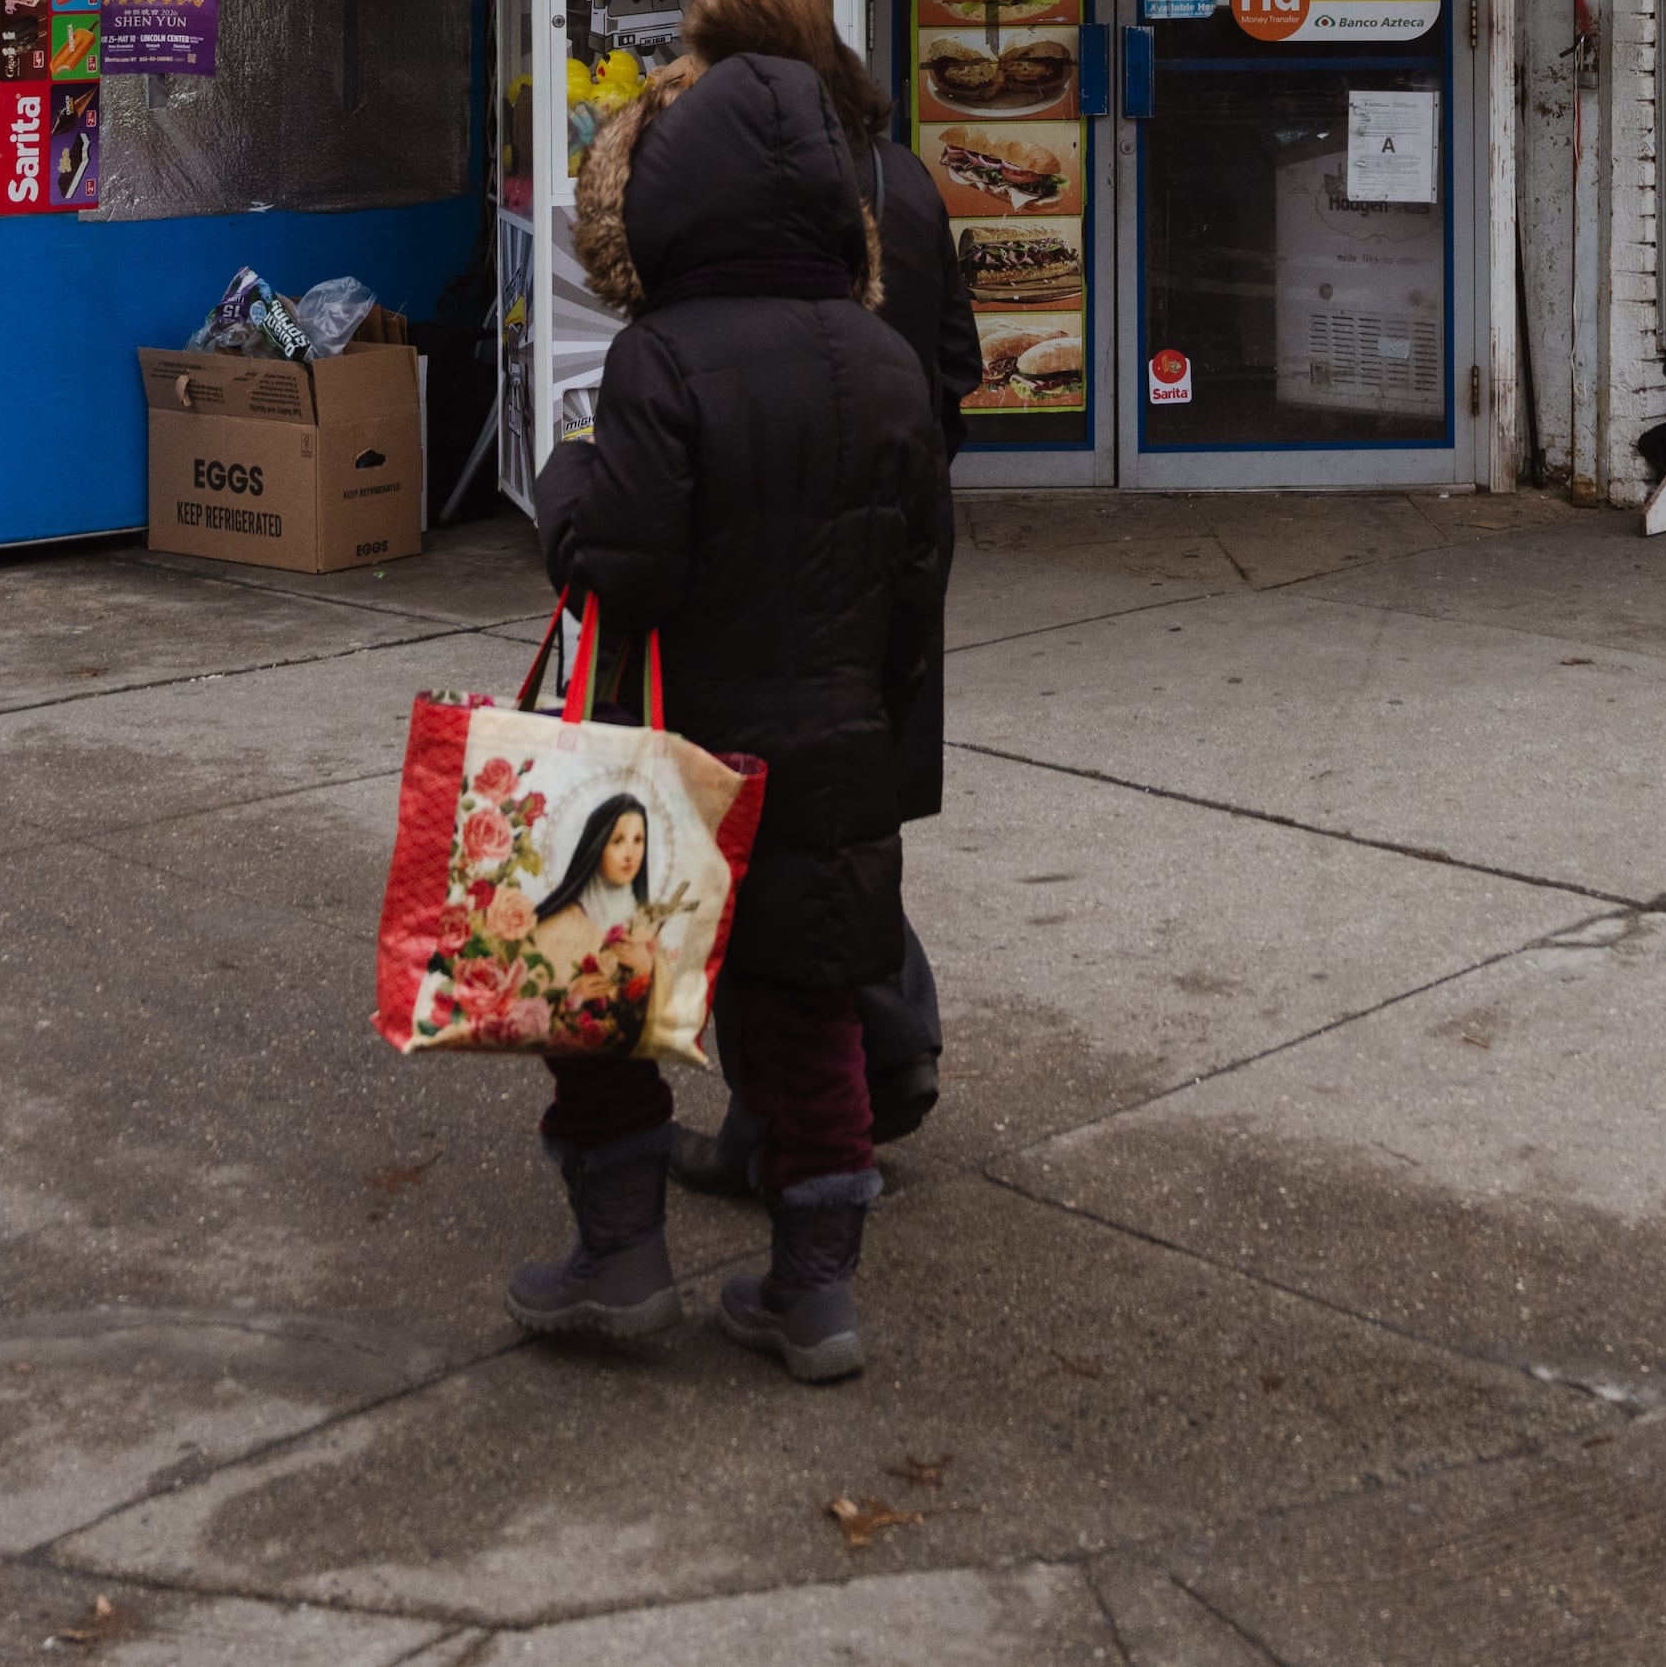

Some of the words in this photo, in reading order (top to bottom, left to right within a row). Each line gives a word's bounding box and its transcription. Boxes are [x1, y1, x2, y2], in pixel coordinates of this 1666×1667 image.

[114, 16, 152, 27] SHEN
[156, 16, 187, 28] YUN
[1241, 15, 1268, 25] Money
[1268, 15, 1300, 24] Transfer
[1339, 17, 1378, 28] Banco
[1381, 17, 1424, 28] Azteca
[140, 34, 166, 43] LINCOLN
[167, 34, 189, 43] CENTER
[8, 96, 42, 203] Sarita
[1382, 137, 1395, 153] A
[223, 304, 242, 318] 15
[1152, 387, 1188, 401] Sarita
[194, 458, 264, 496] EGGS
[343, 488, 358, 500] KEEP
[359, 481, 402, 499] REFRIGERATED
[177, 500, 203, 527] KEEP
[206, 505, 282, 538] REFRIGERATED
[356, 540, 389, 557] EGGS
